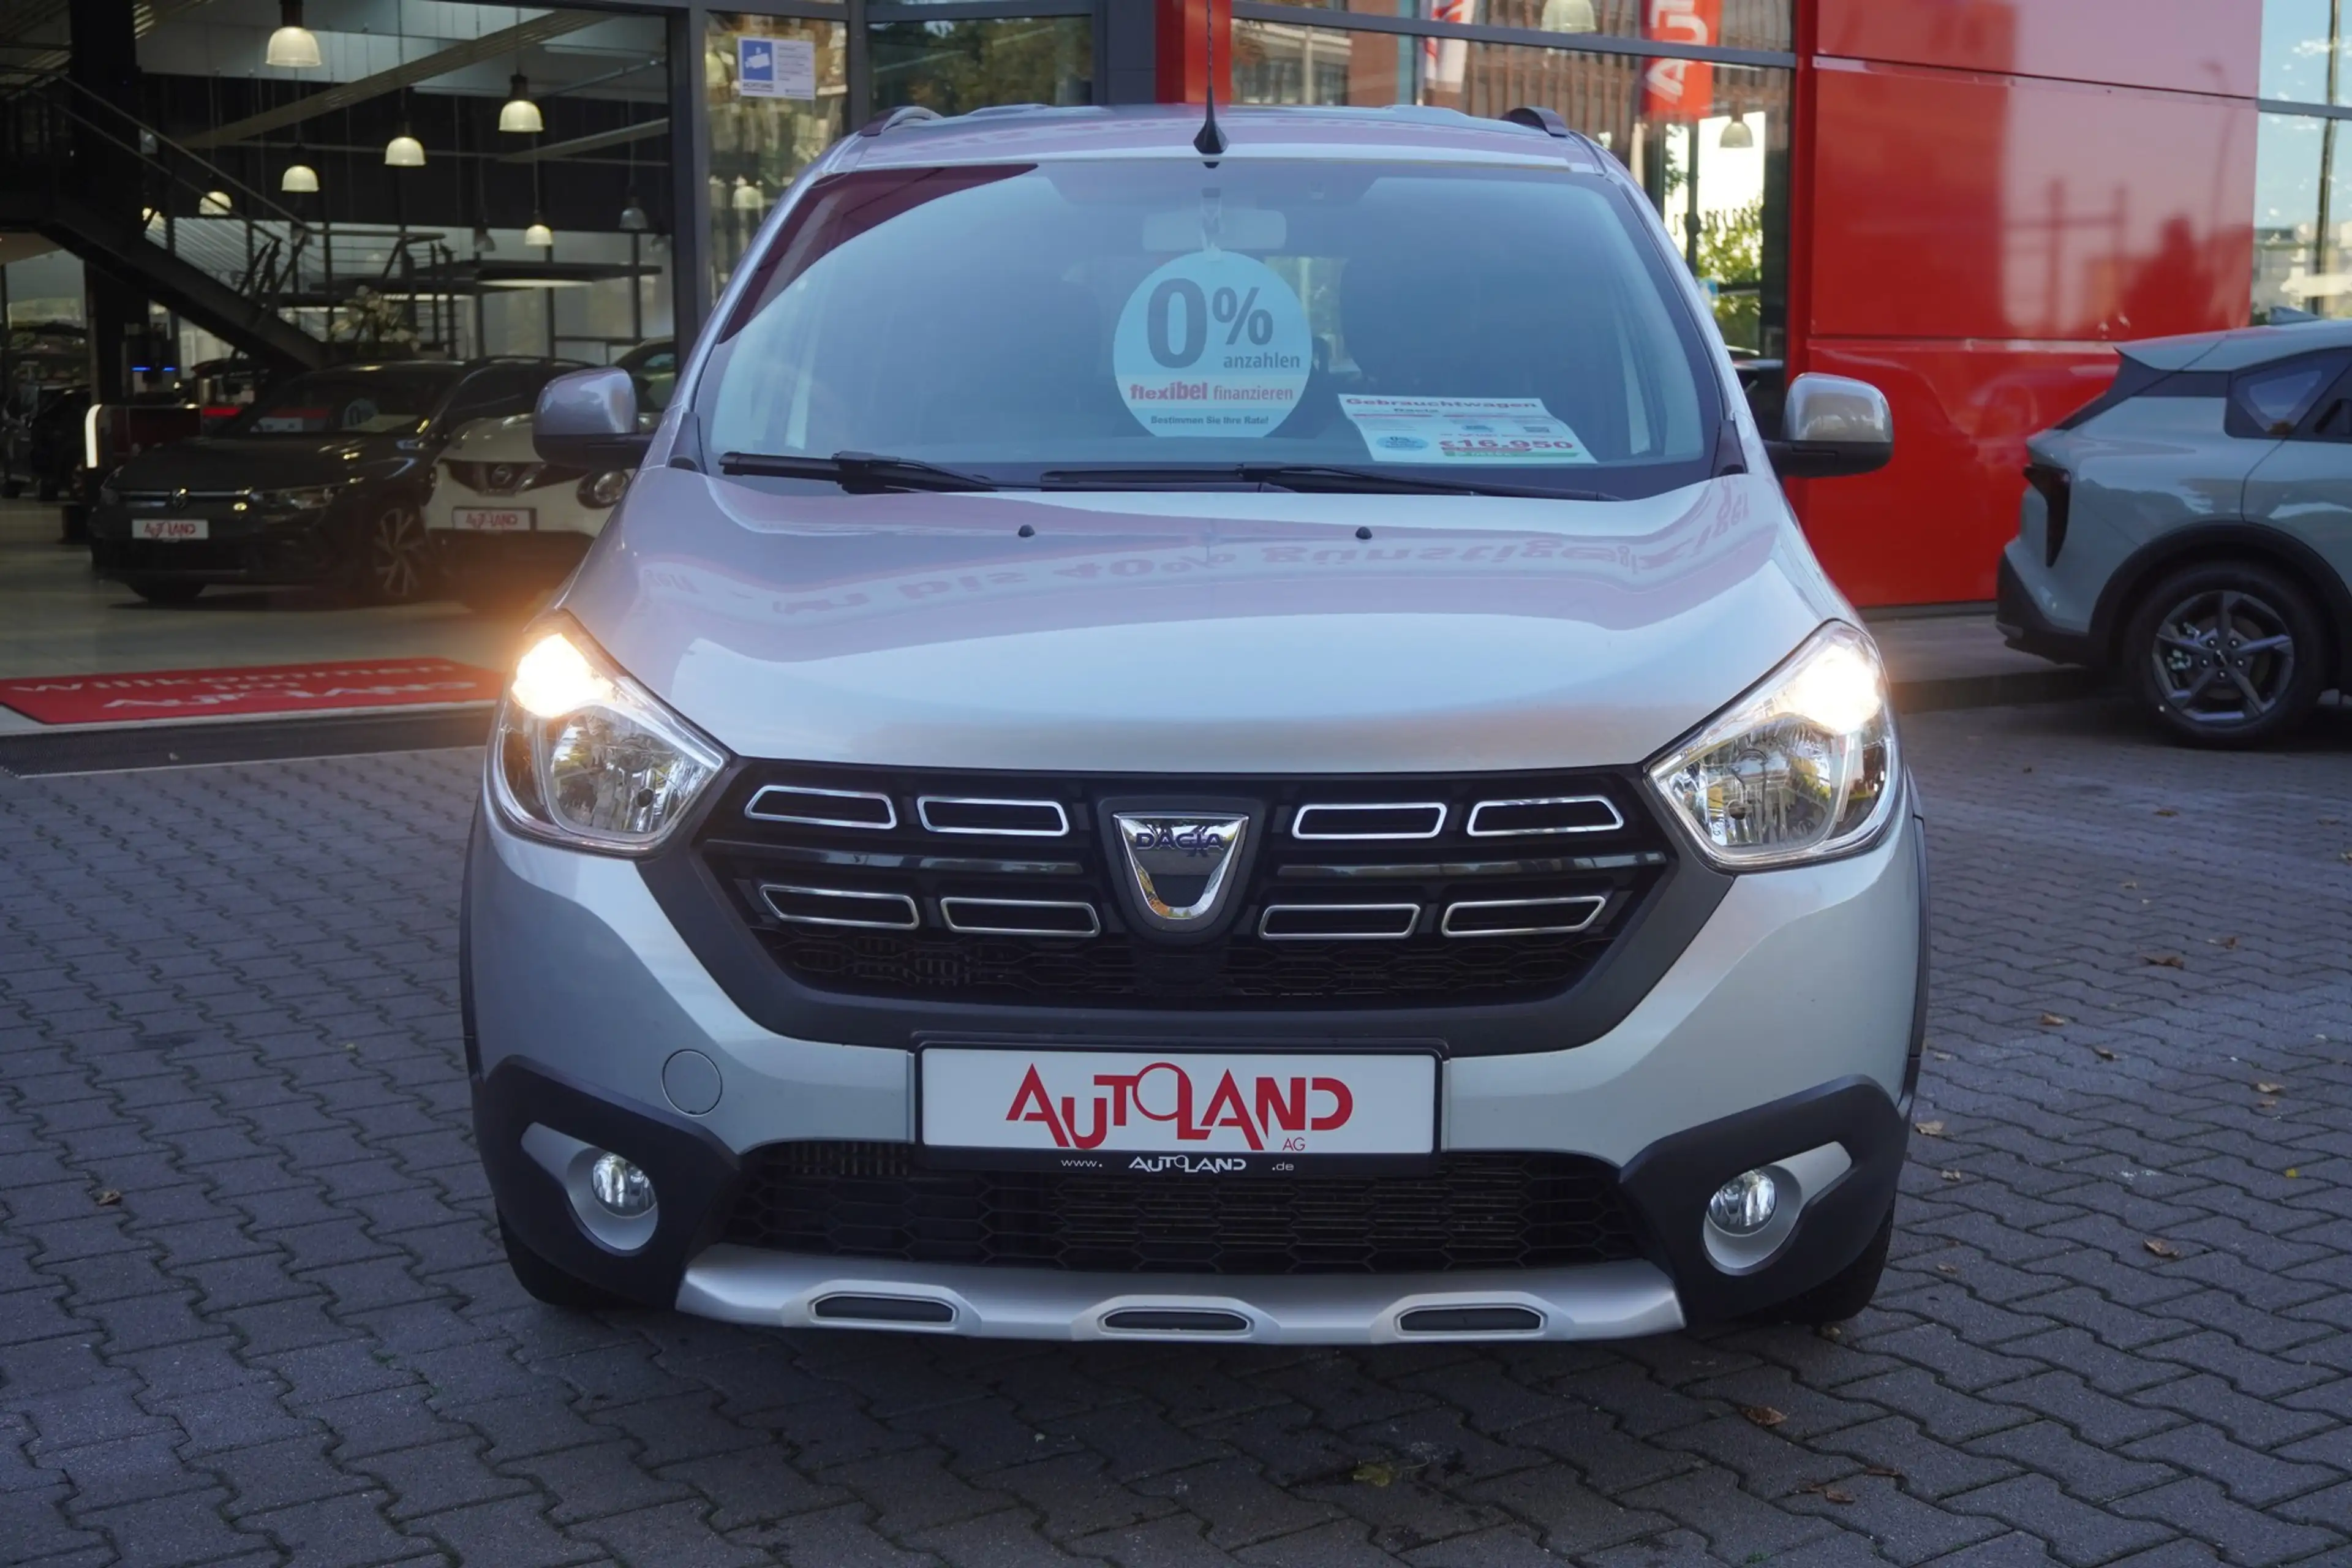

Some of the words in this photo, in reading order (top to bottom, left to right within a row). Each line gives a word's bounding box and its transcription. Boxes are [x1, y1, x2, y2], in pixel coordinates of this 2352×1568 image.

[1147, 277, 1273, 368] 0%
[1223, 352, 1300, 369] anzahlen
[1130, 381, 1208, 401] flexibel
[1213, 385, 1294, 401] finanzieren
[1346, 398, 1539, 409] Gebrauchtwagen
[1150, 415, 1204, 424] Bestimmen
[1206, 415, 1221, 425] Sie
[1223, 415, 1242, 425] Ihre
[1243, 415, 1269, 425] Rate!
[1136, 832, 1224, 850] DACIA
[1006, 1062, 1354, 1151] AUTOLAND
[1283, 1137, 1306, 1152] AG
[1061, 1158, 1103, 1168] www.
[1128, 1155, 1247, 1174] AUTOLAND
[1271, 1162, 1294, 1171] .de
